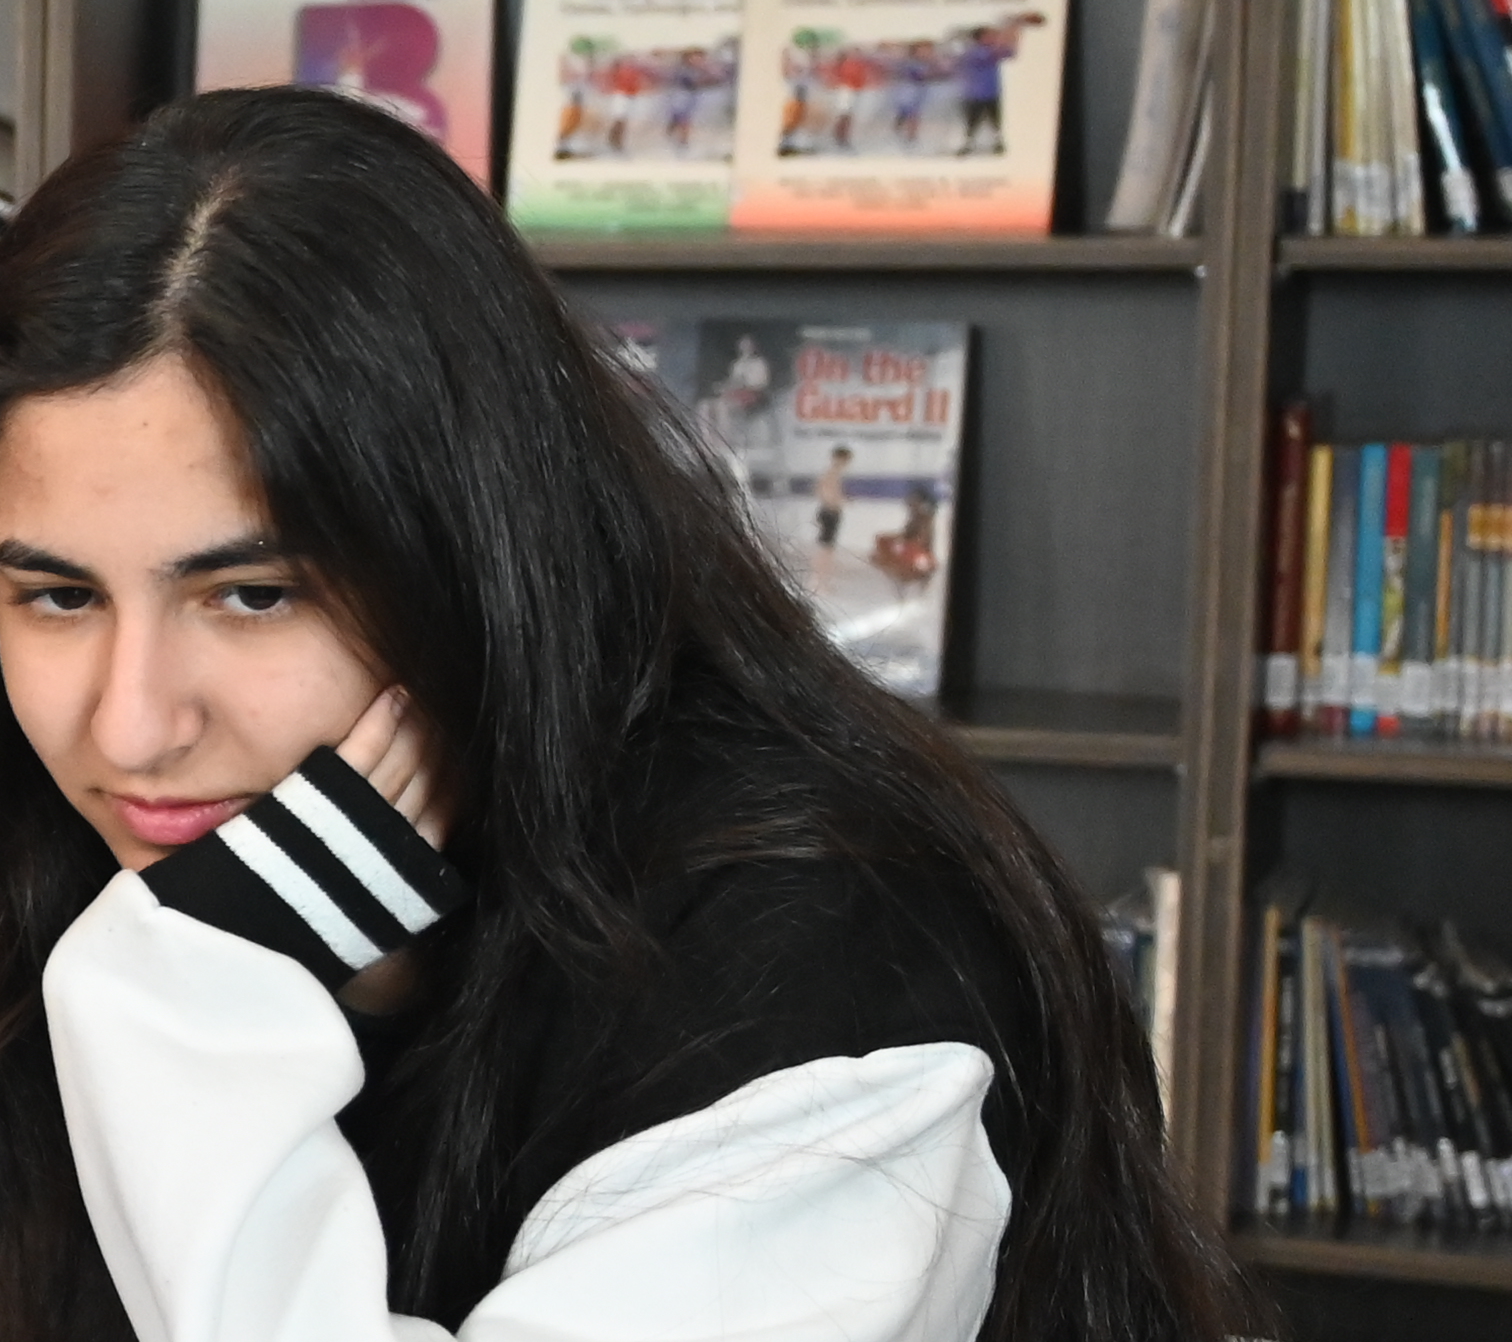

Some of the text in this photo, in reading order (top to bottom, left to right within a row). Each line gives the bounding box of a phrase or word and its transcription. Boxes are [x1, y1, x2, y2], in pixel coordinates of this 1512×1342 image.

[794, 346, 927, 385] On the
[793, 388, 914, 425] Guard
